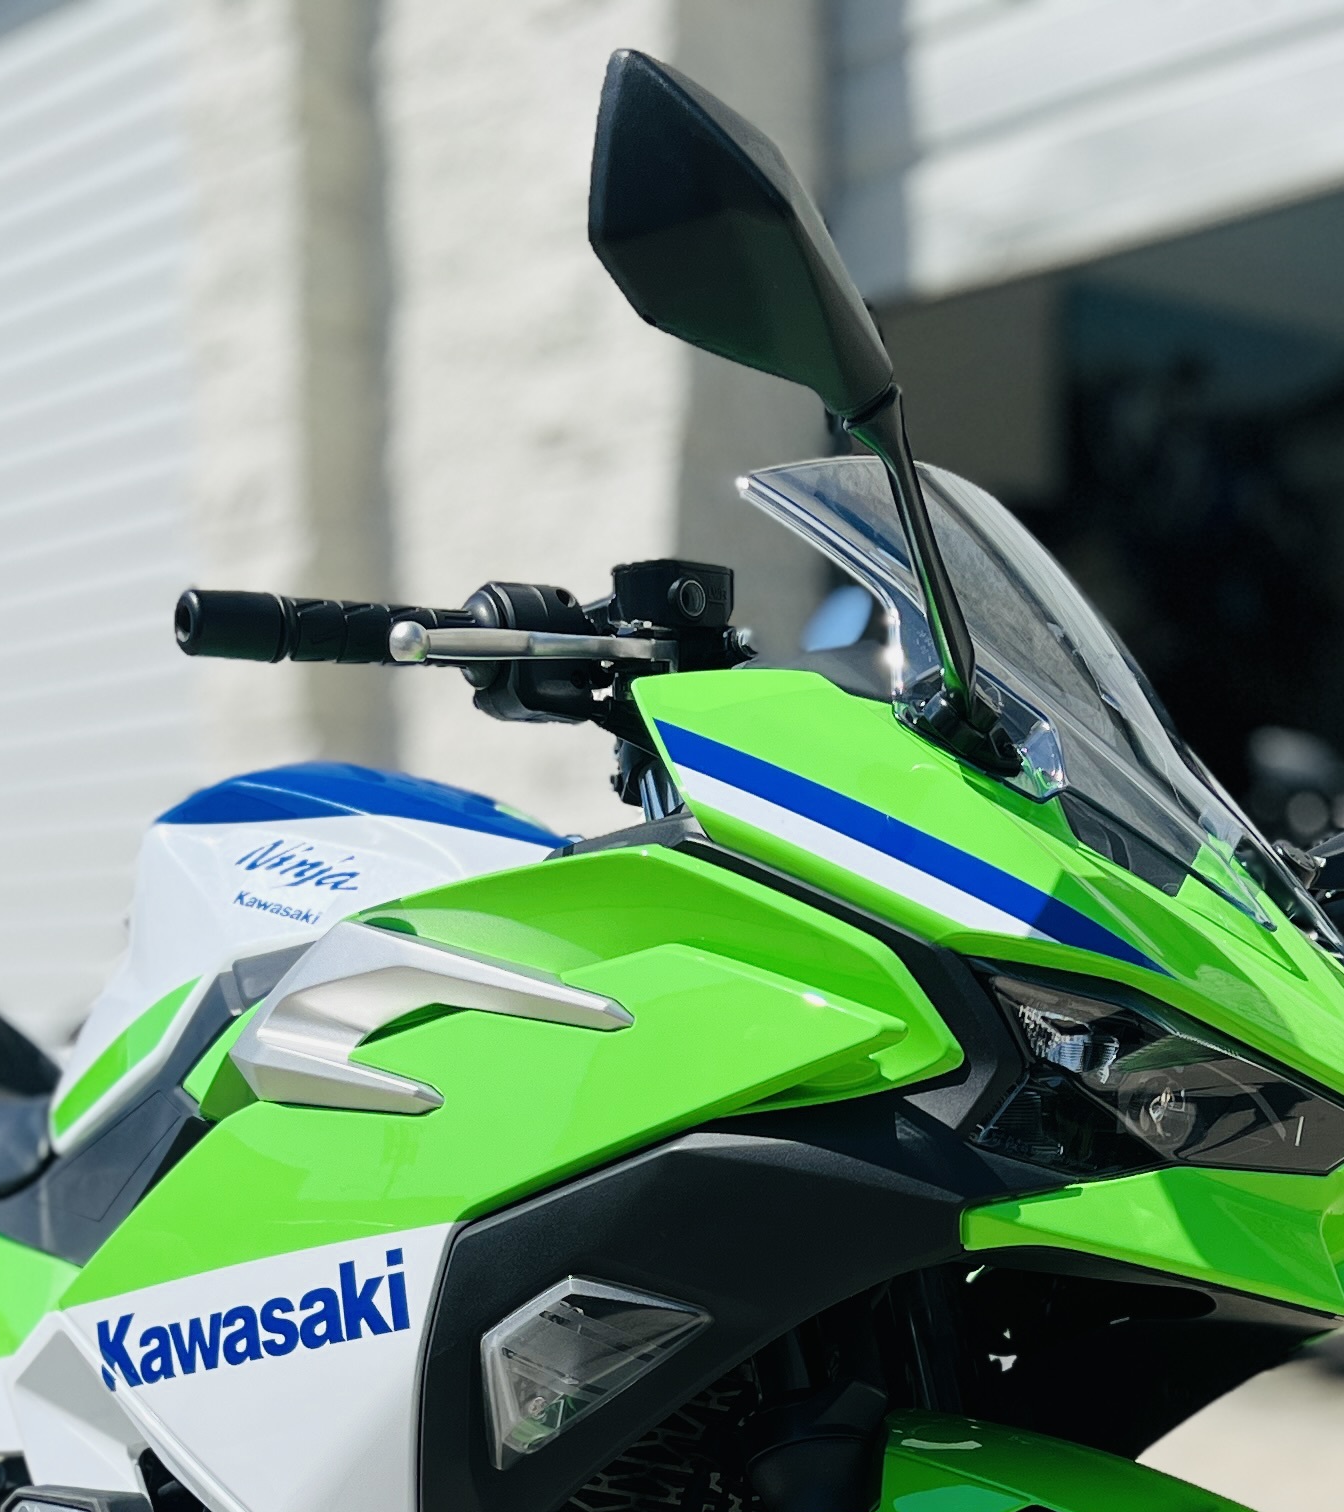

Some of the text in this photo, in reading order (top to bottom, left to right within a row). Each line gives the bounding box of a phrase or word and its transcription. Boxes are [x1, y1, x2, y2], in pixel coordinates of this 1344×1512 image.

[235, 839, 358, 892] Ninja
[232, 890, 322, 926] Kawasaki
[96, 1248, 410, 1392] Kawasaki
